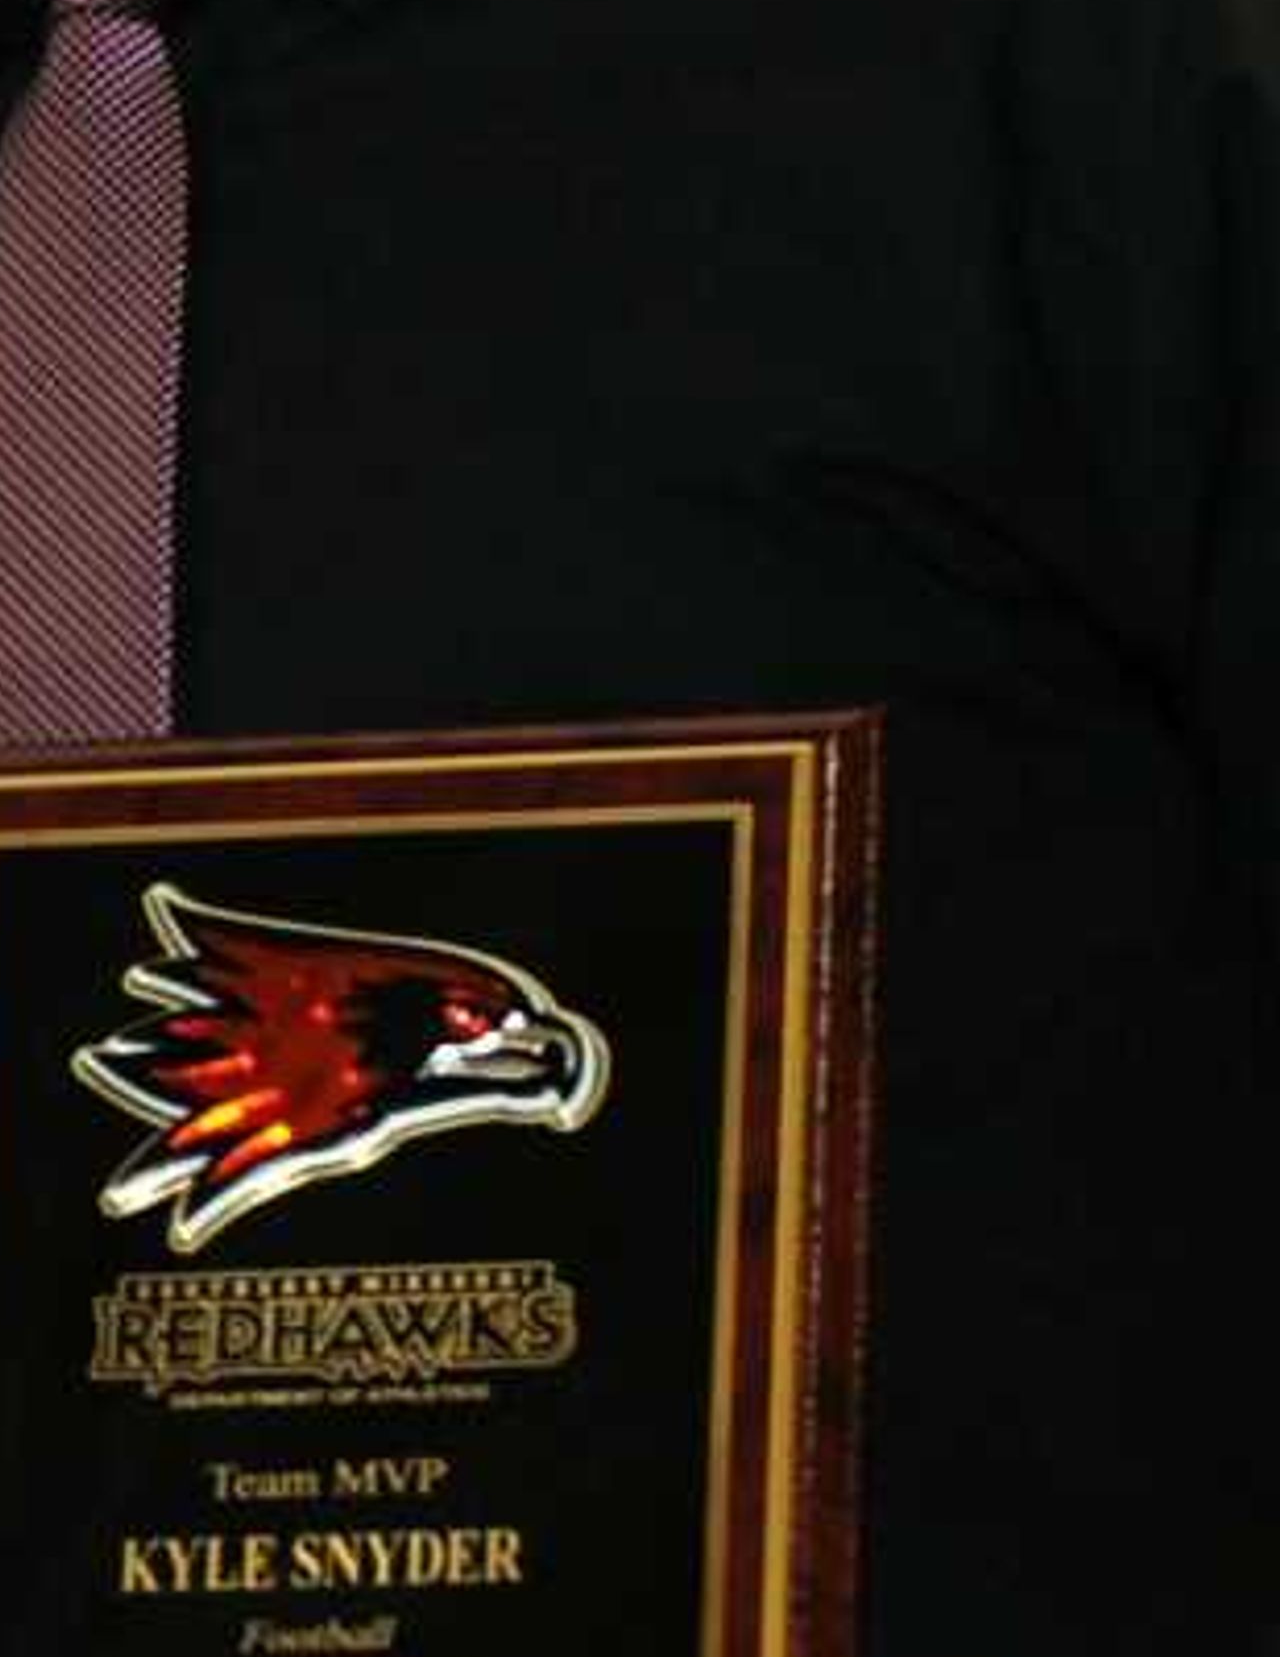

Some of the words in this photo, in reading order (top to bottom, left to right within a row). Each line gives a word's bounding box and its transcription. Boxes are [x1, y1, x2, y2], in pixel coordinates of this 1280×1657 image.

[102, 1289, 568, 1375] REDHAWKS
[207, 1461, 321, 1500] Team
[331, 1457, 448, 1494] MVP
[121, 1533, 278, 1593] KYLE
[288, 1527, 523, 1589] SNYDER
[239, 1615, 398, 1654] Football
